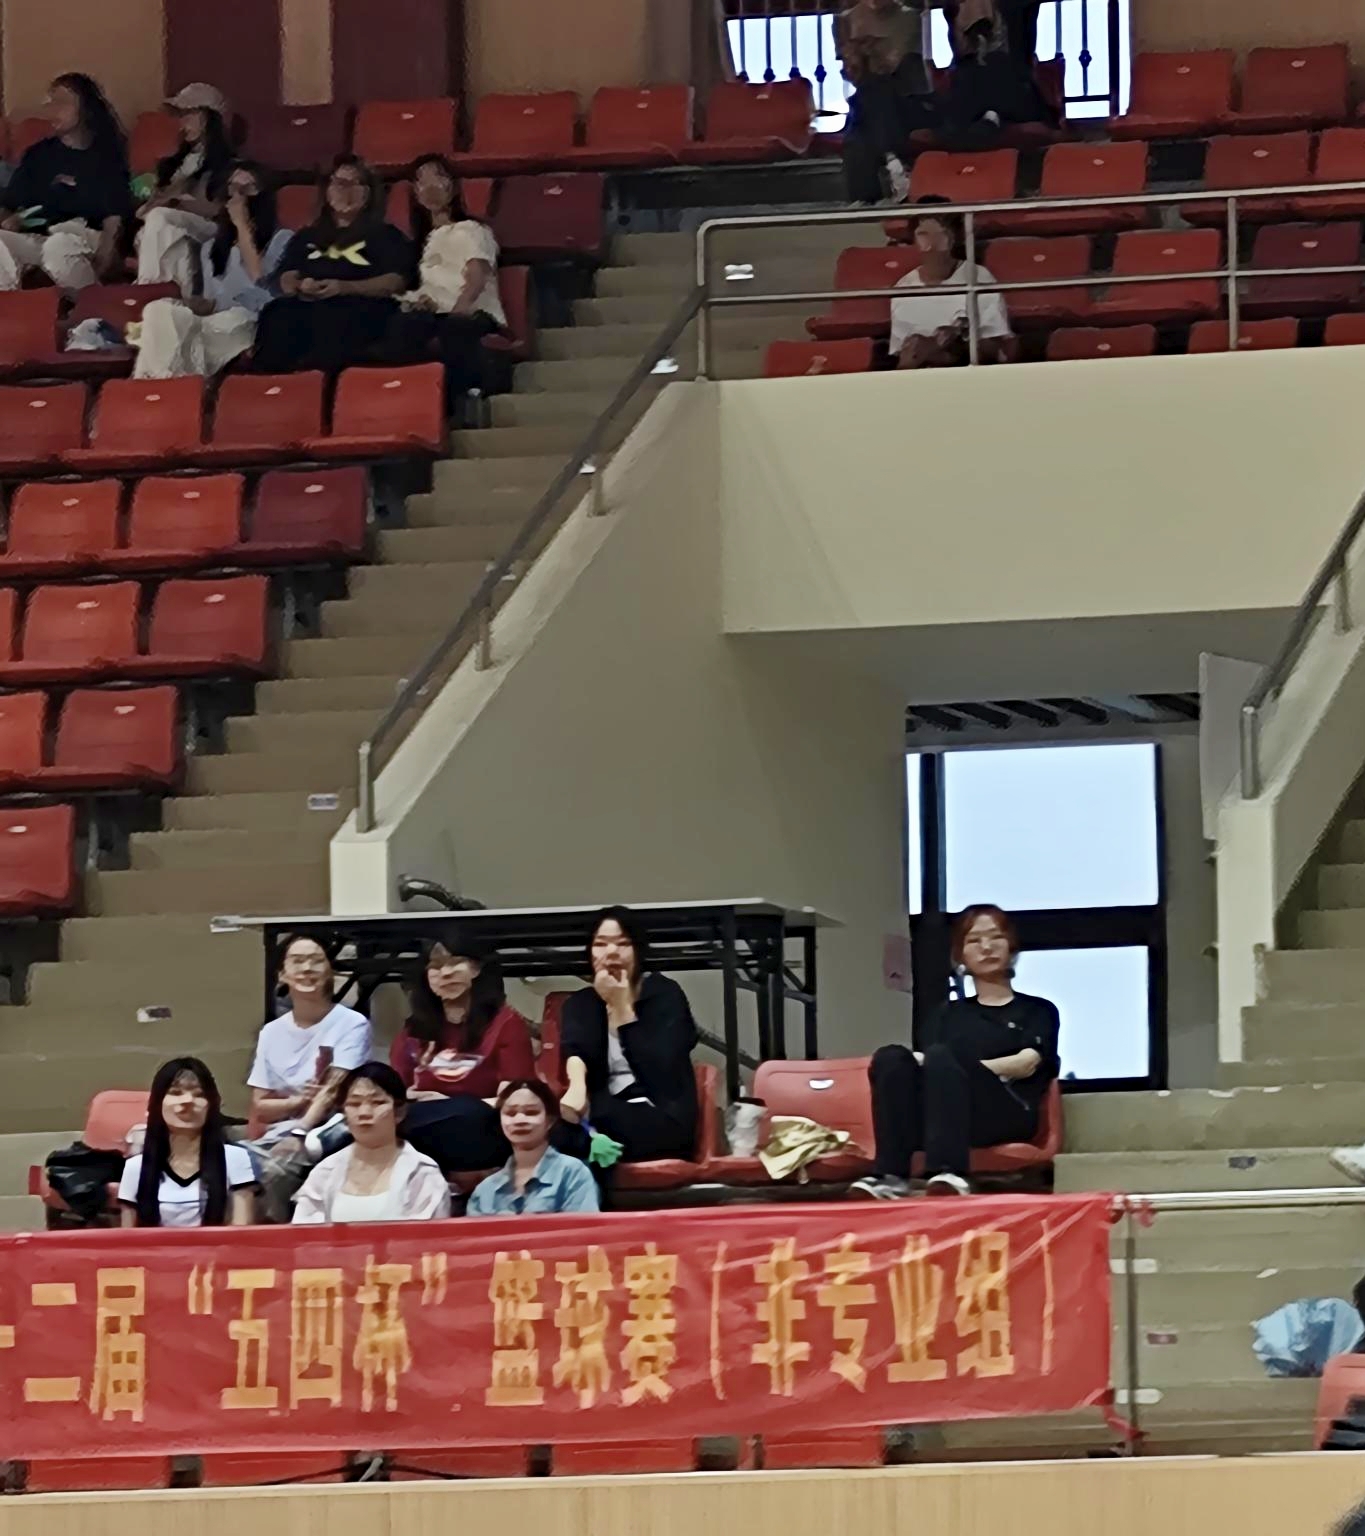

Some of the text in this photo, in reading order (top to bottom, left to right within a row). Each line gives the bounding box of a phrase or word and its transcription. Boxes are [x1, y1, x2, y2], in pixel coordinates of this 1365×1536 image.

[0, 1219, 1057, 1422] 二届“五四杯”篮球赛（非专业组）
